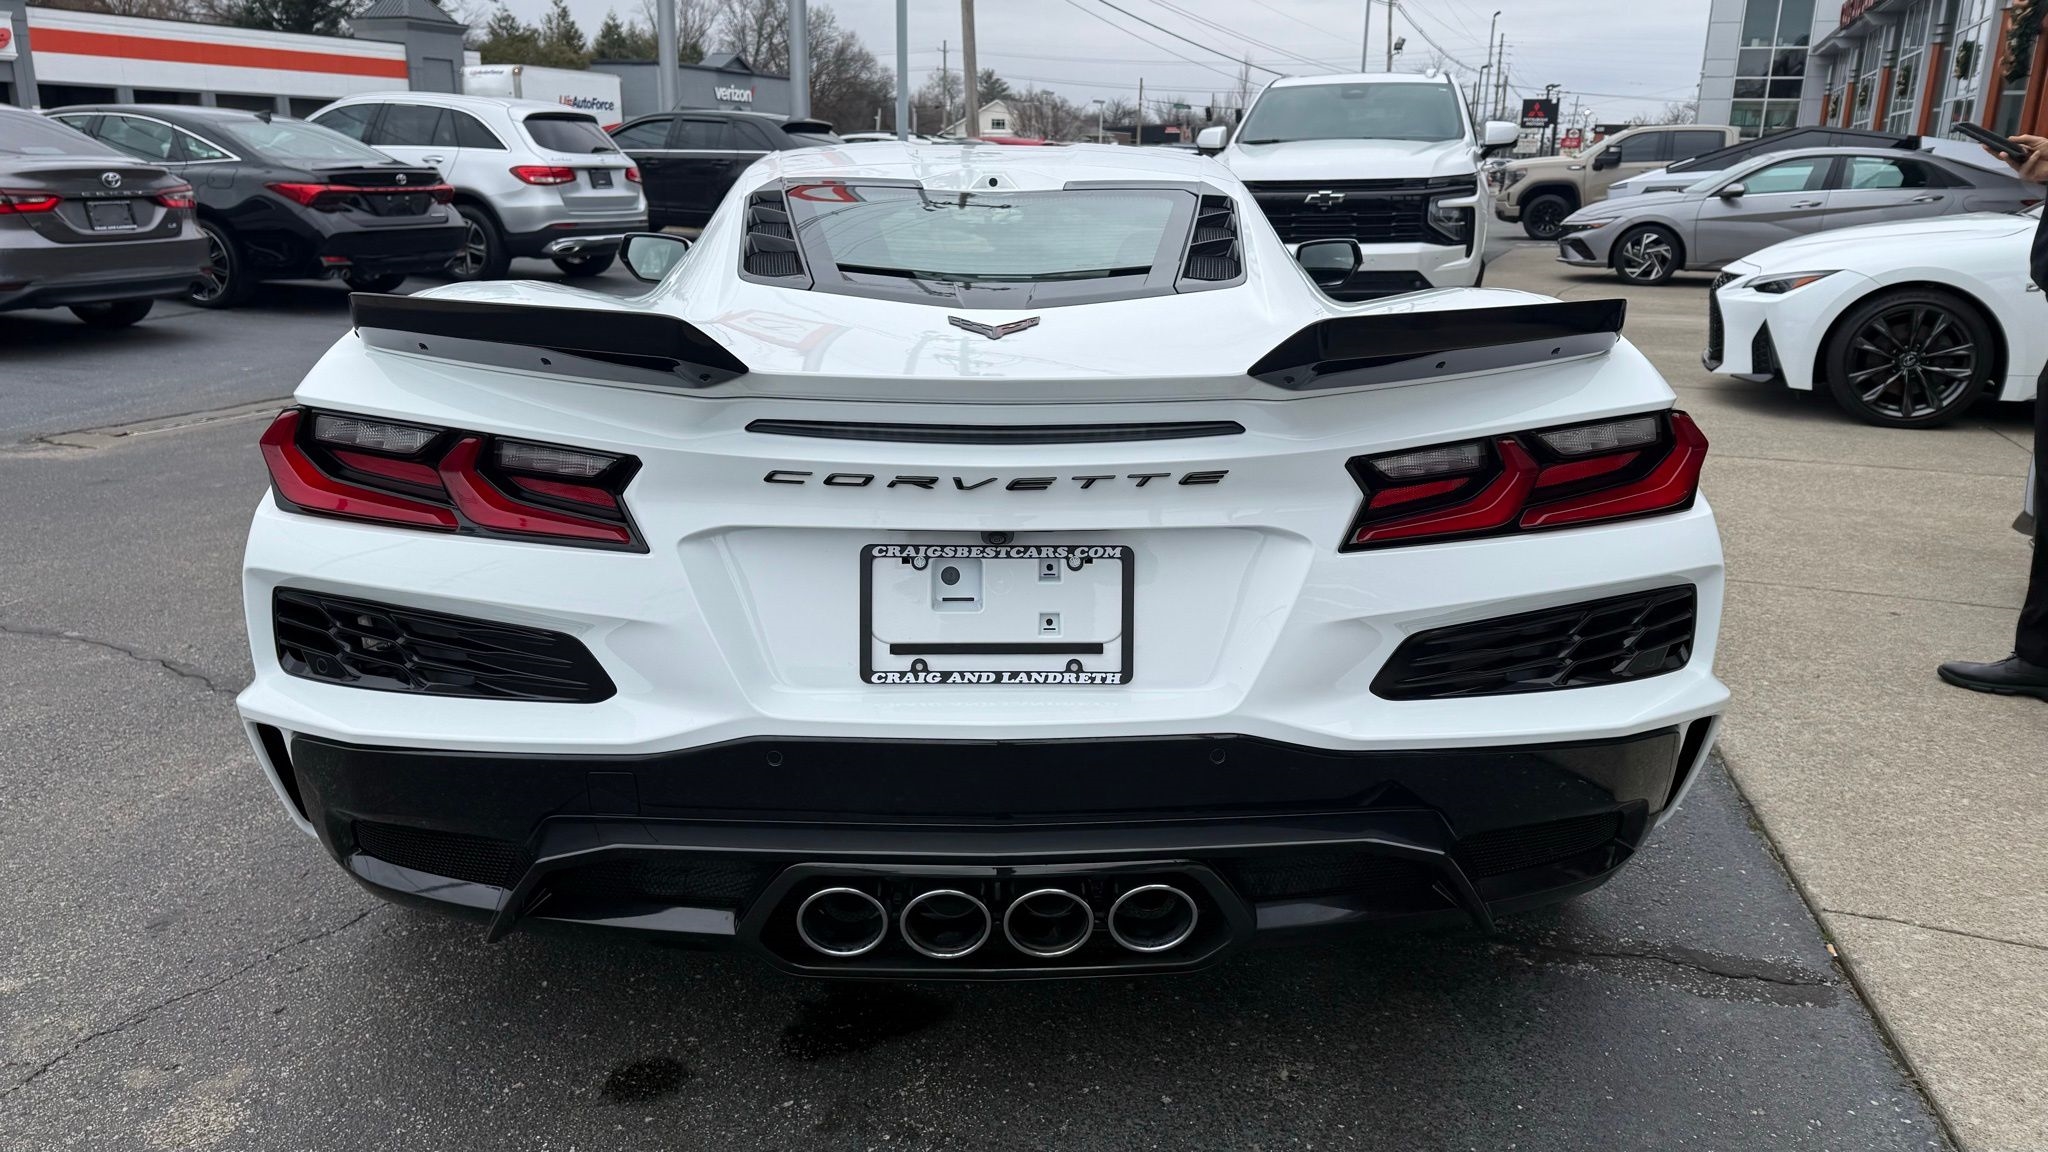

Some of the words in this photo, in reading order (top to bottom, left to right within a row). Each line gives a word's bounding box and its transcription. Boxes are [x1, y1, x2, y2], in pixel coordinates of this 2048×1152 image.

[714, 84, 752, 103] verizon
[763, 469, 1230, 491] CORVETTE
[871, 545, 1123, 559] CRAIGSBESTCARS.COM
[870, 672, 943, 684] CRAIG
[946, 672, 996, 684] AND
[1000, 672, 1122, 684] LANDRETH
